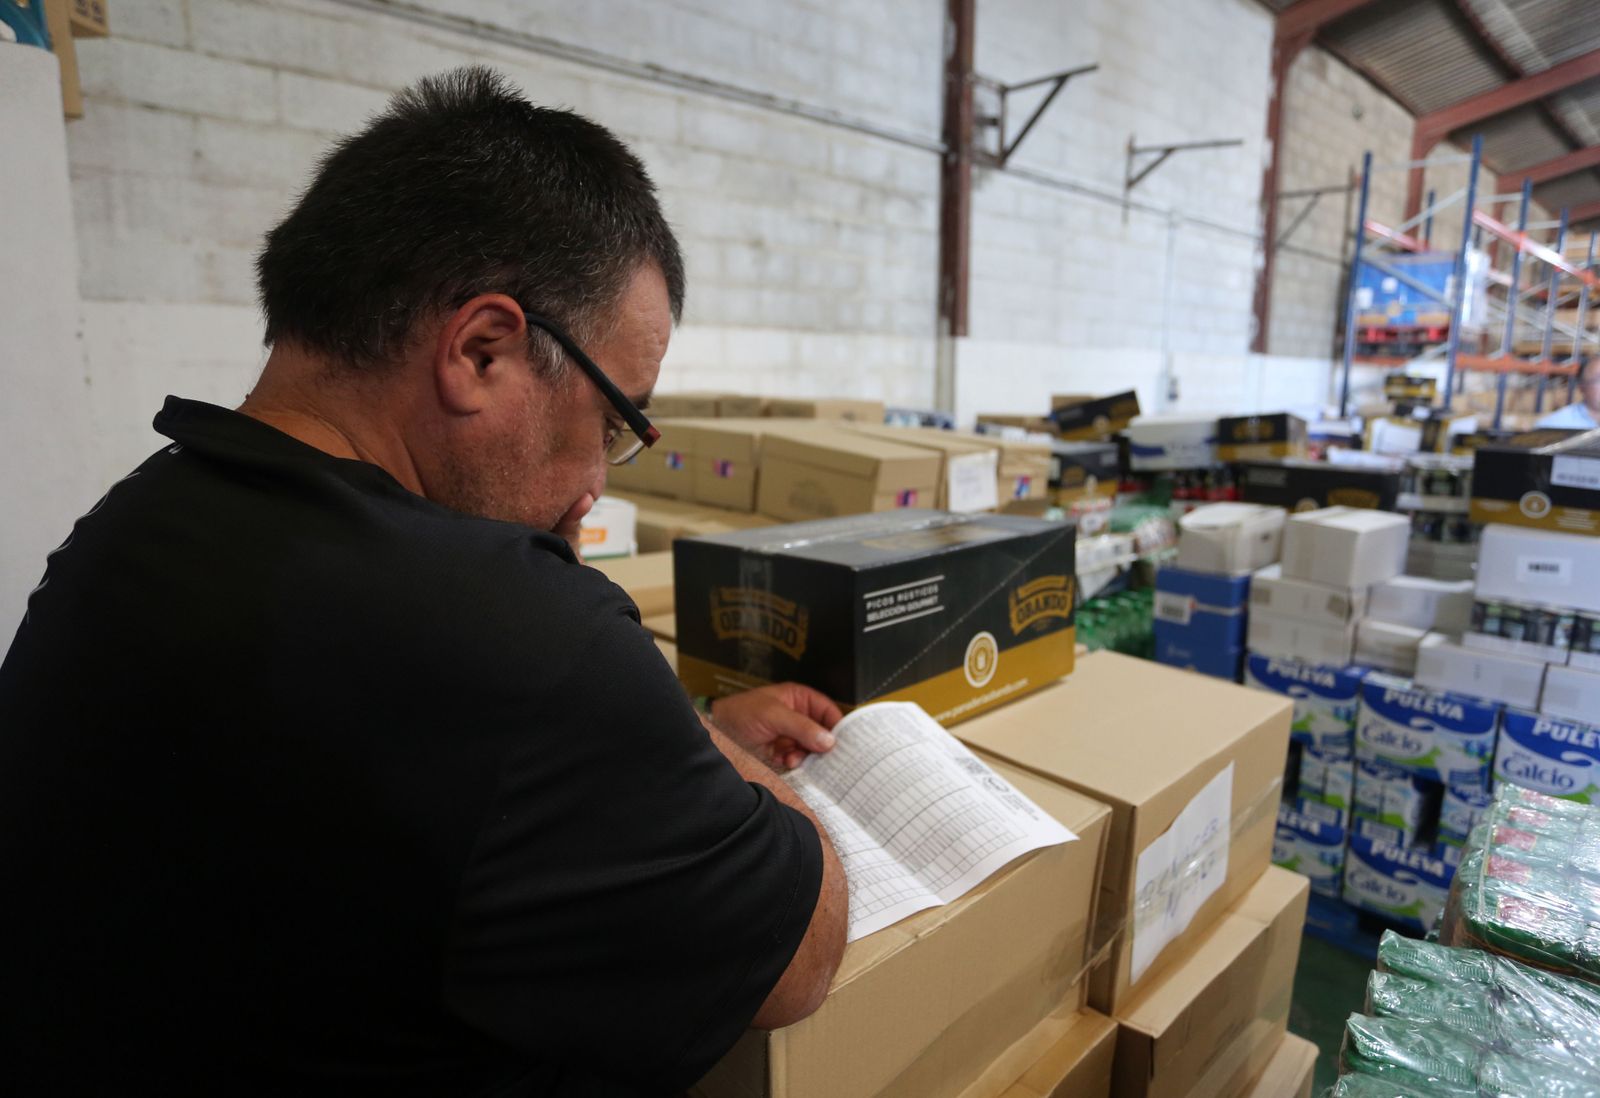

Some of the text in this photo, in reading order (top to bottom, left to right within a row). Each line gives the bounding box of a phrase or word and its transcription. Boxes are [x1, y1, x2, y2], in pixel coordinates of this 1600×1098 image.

[866, 595, 895, 611] PICOS
[1016, 593, 1068, 625] OBANDO
[1267, 656, 1335, 689] PULEVA
[1384, 688, 1464, 720] PULEVA
[1362, 724, 1422, 753] Calcio
[1503, 757, 1574, 788] Calcio
[1370, 837, 1444, 878] PULEVA
